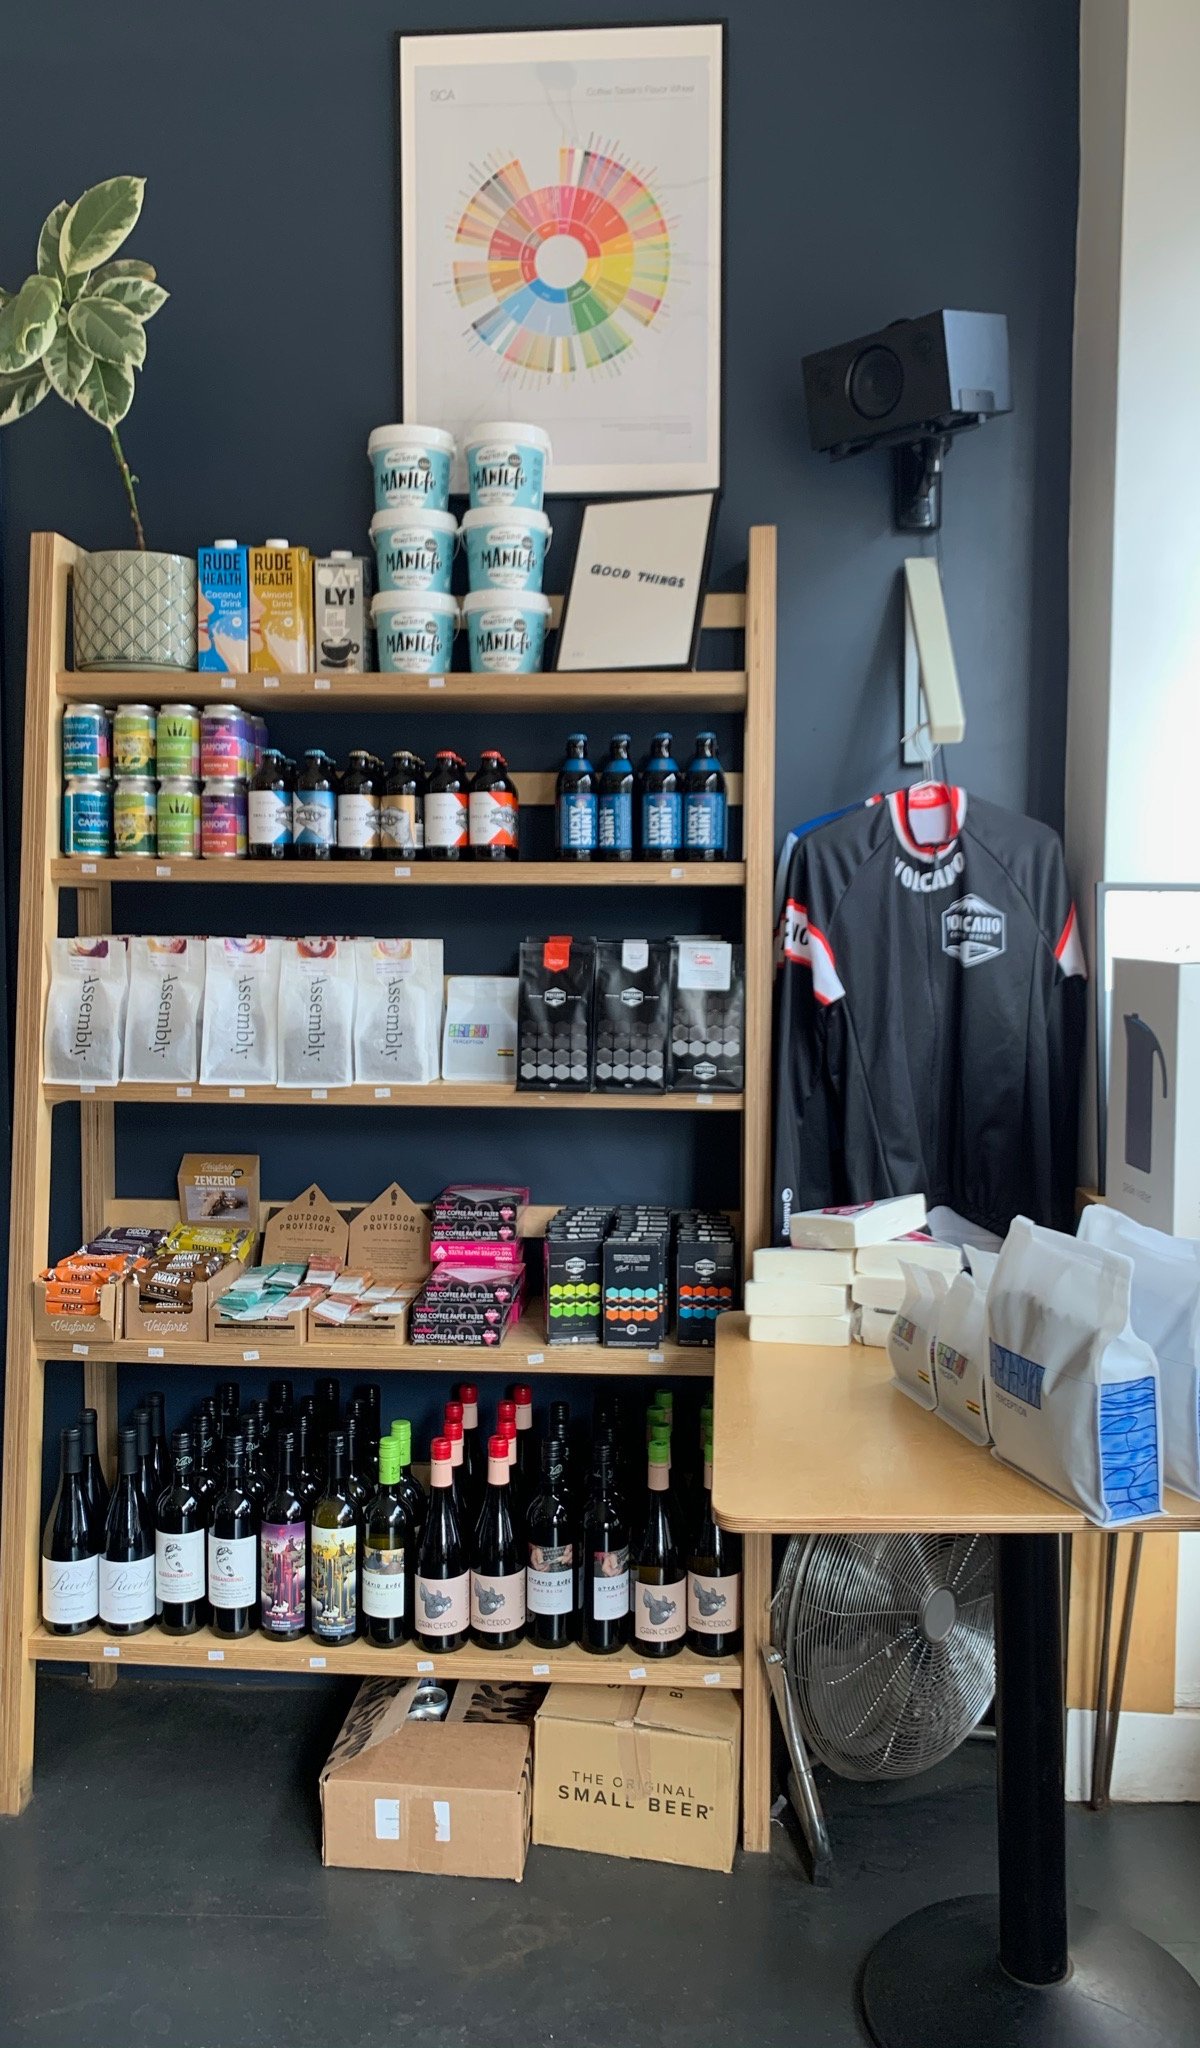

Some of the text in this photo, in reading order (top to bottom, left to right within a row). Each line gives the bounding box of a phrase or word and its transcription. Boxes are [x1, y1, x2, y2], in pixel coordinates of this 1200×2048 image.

[430, 89, 455, 101] SCA
[203, 553, 241, 571] RUDE
[254, 553, 292, 571] RUDE
[203, 572, 242, 585] HEALTH
[254, 572, 293, 585] HEALTH
[590, 564, 686, 588] GOOD THINGS
[205, 590, 242, 599] Coconut
[261, 591, 292, 599] Almond
[325, 588, 355, 605] LY!
[220, 600, 241, 608] Drink
[272, 600, 292, 608] Drink
[569, 805, 581, 846] LUCKY
[581, 806, 592, 846] SAINT
[604, 808, 615, 846] SAINT
[649, 805, 660, 845] LUCKY
[661, 806, 672, 845] SAINT
[688, 805, 699, 845] LUCKY
[698, 806, 711, 845] SAINT
[69, 975, 99, 1060] Assembly
[149, 974, 178, 1058] Assembly
[231, 974, 255, 1059] Assembly
[303, 976, 328, 1061] Assembly
[380, 977, 404, 1061] Assembly
[194, 1175, 236, 1186] ZENZERO
[287, 1214, 331, 1223] OUTDOOR
[370, 1214, 416, 1223] OUTDOOR
[279, 1222, 336, 1234] PROVISIONS
[363, 1222, 422, 1234] PROVISIONS
[172, 1253, 201, 1261] AVANTI
[151, 1272, 181, 1285] AVANTI
[50, 1319, 96, 1335] Veloforte
[143, 1319, 189, 1335] Veloforte
[995, 1391, 1028, 1417] PERCEPTION
[418, 1619, 458, 1630] GRAN CERDO
[486, 1617, 512, 1627] CERDO
[707, 1618, 732, 1628] CERDO
[640, 1625, 681, 1636] GRAN CERDO
[572, 1770, 695, 1799] THE ORIGINAL
[558, 1785, 635, 1809] SMALL
